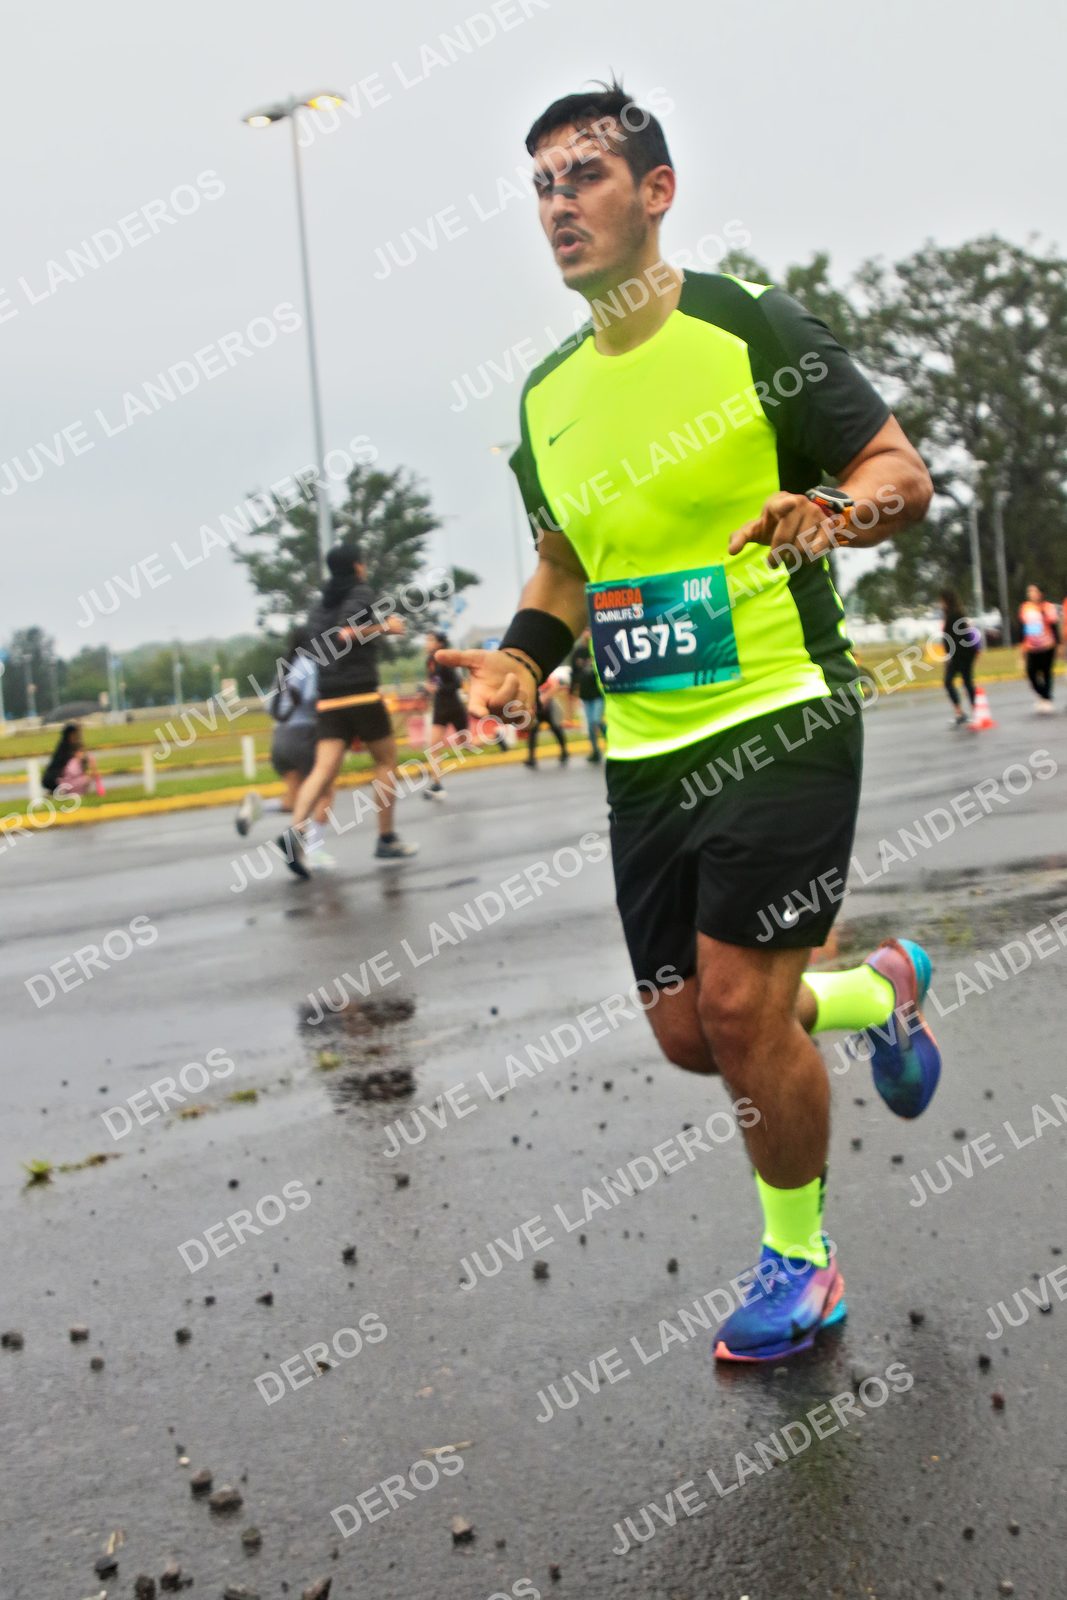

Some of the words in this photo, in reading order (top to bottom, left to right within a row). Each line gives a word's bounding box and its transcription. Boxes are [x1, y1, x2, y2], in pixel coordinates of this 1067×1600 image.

[593, 587, 643, 610] CARRERA
[683, 576, 713, 603] 10K
[595, 607, 633, 623] OMNILIFE
[614, 620, 697, 661] 1575
